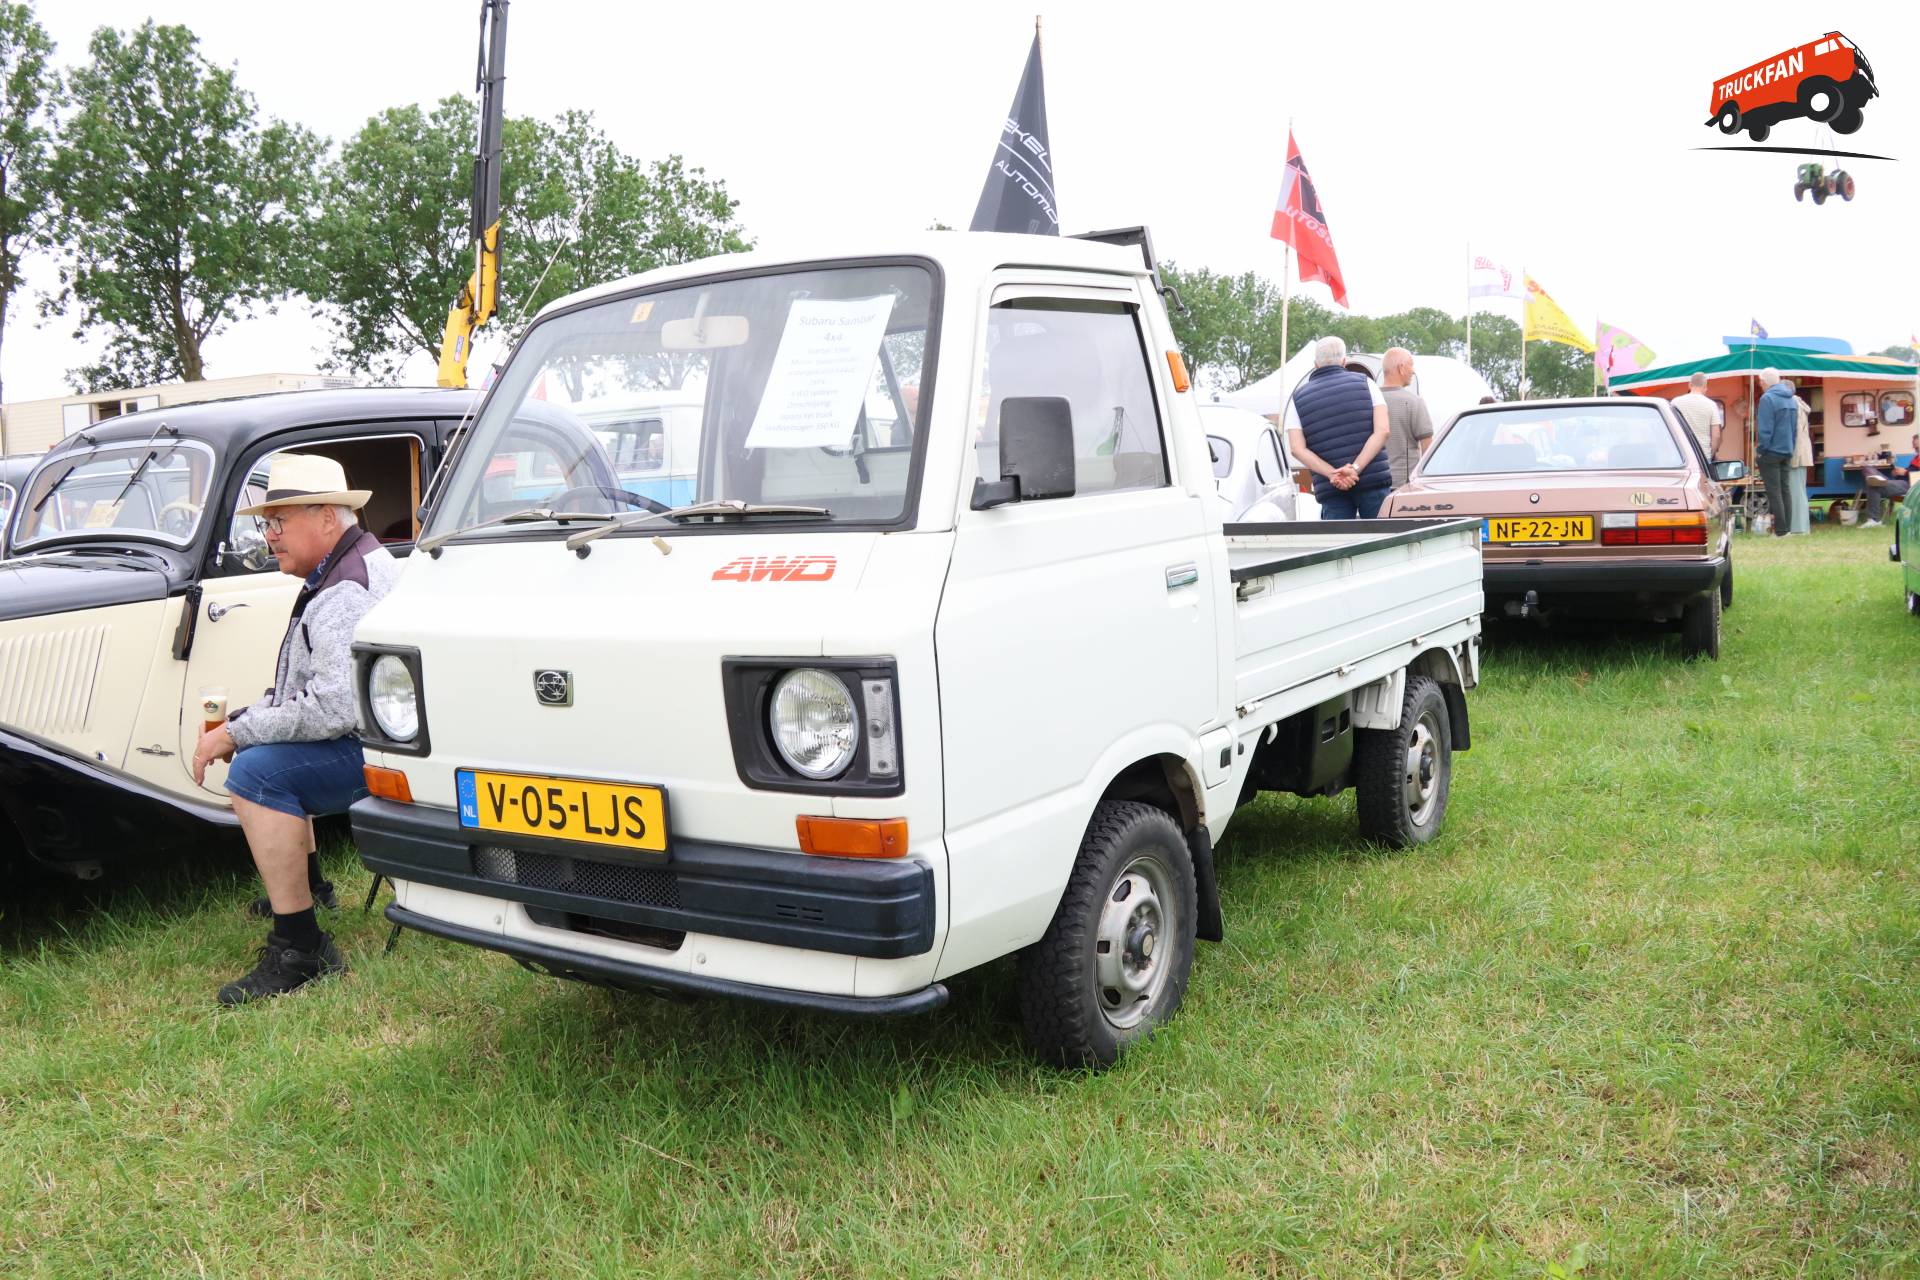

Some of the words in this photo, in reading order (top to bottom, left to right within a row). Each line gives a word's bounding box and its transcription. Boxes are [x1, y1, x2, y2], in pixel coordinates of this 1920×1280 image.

[1634, 493, 1649, 505] NL
[1496, 520, 1584, 539] NF-22-JN
[711, 555, 837, 583] 4WD
[463, 804, 477, 818] NL
[487, 781, 646, 839] V-05-LJS
